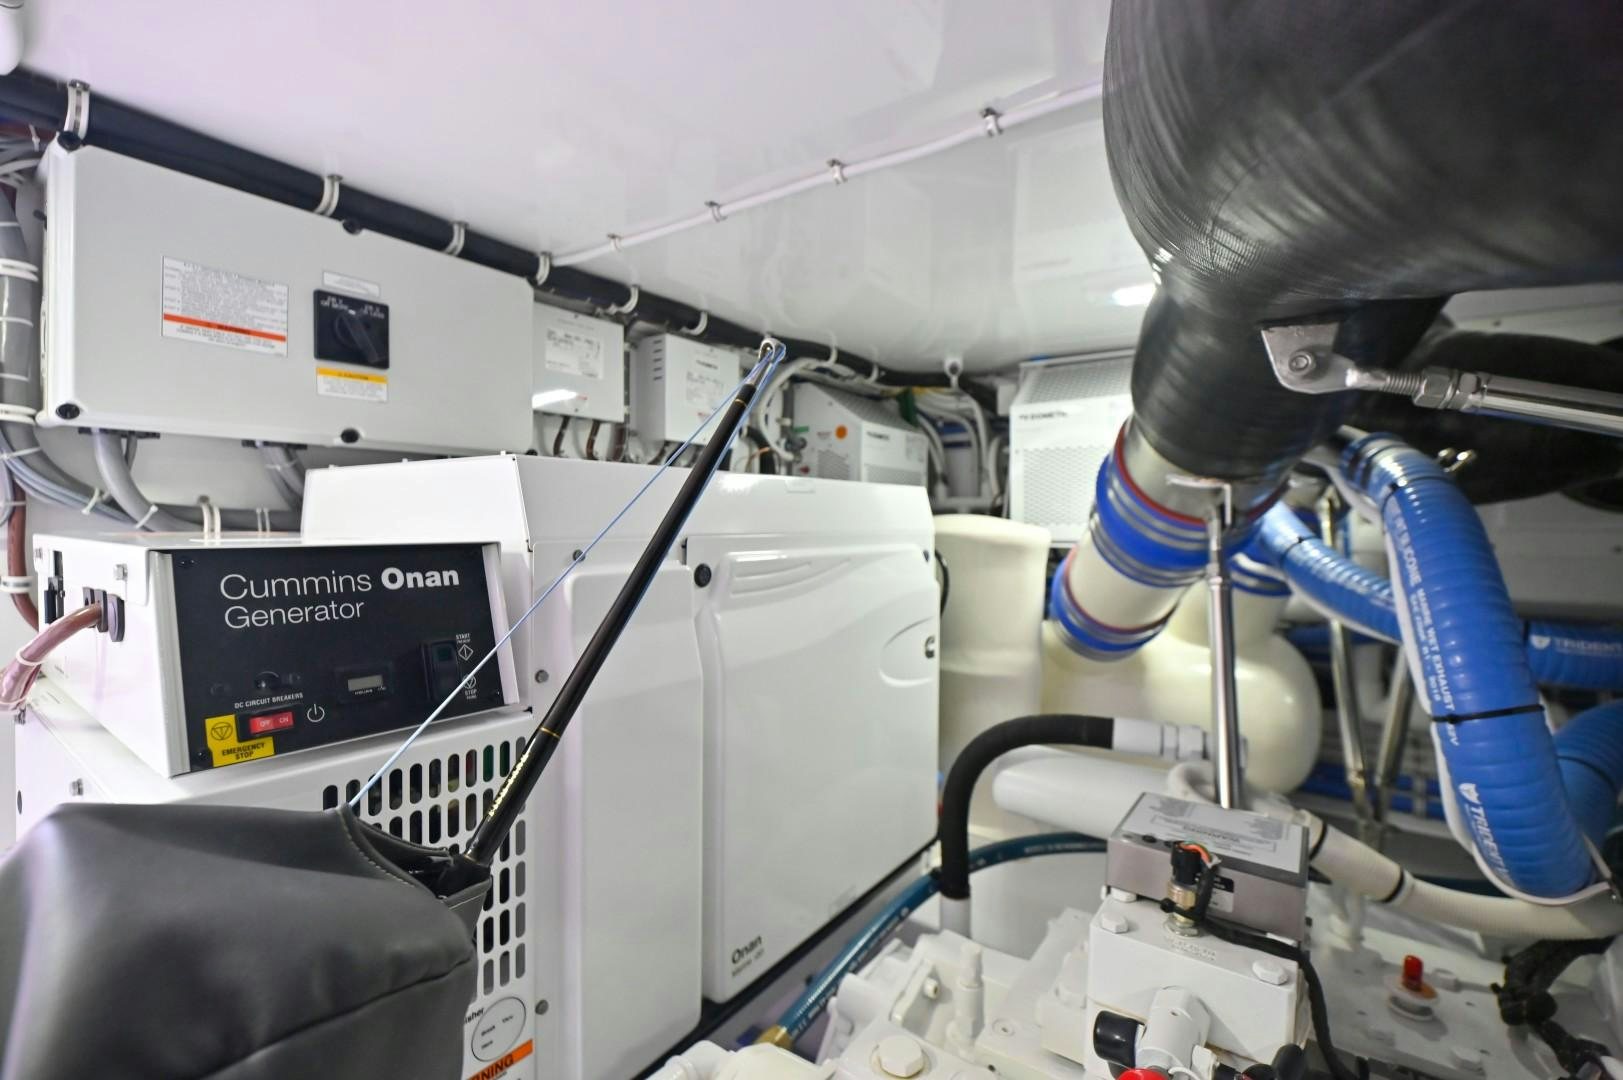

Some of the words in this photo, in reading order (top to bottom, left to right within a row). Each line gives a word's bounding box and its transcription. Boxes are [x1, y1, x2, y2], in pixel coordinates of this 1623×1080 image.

[220, 570, 372, 600] Cummins
[381, 567, 460, 590] Onan
[225, 600, 364, 629] Generator
[1432, 654, 1455, 711] EXHAUST
[245, 698, 270, 707] CIRCUIT
[272, 692, 303, 703] BREAKERS
[279, 716, 289, 724] ON
[221, 742, 266, 757] EMERGENCY
[235, 751, 254, 760] STOP
